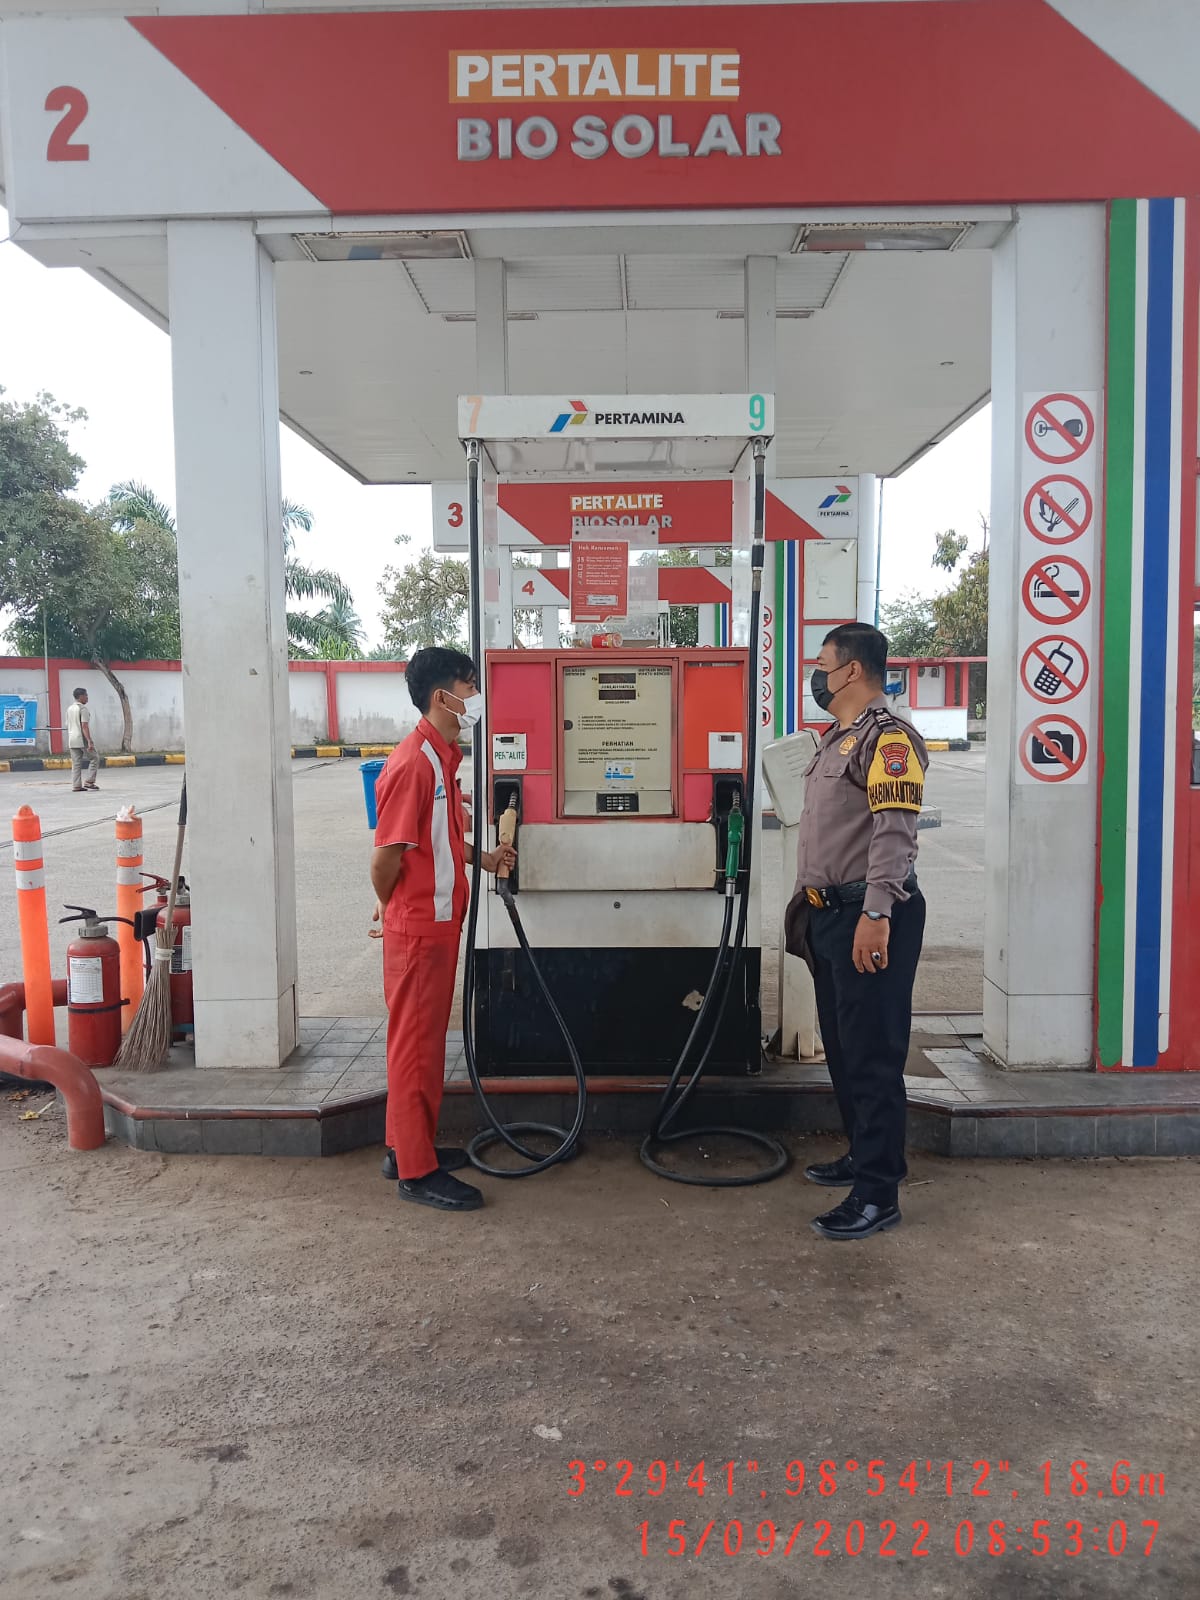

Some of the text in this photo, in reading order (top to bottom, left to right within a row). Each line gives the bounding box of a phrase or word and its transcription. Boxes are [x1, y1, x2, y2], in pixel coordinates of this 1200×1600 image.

[456, 54, 740, 97] PERTALITE
[45, 85, 89, 162] 2
[456, 112, 783, 161] BIO SOLAR
[466, 396, 483, 433] 7
[595, 412, 685, 425] PERTAMINA
[749, 394, 765, 431] 9
[447, 502, 464, 528] 3
[571, 494, 664, 511] PERTALITE
[521, 580, 535, 596] 4
